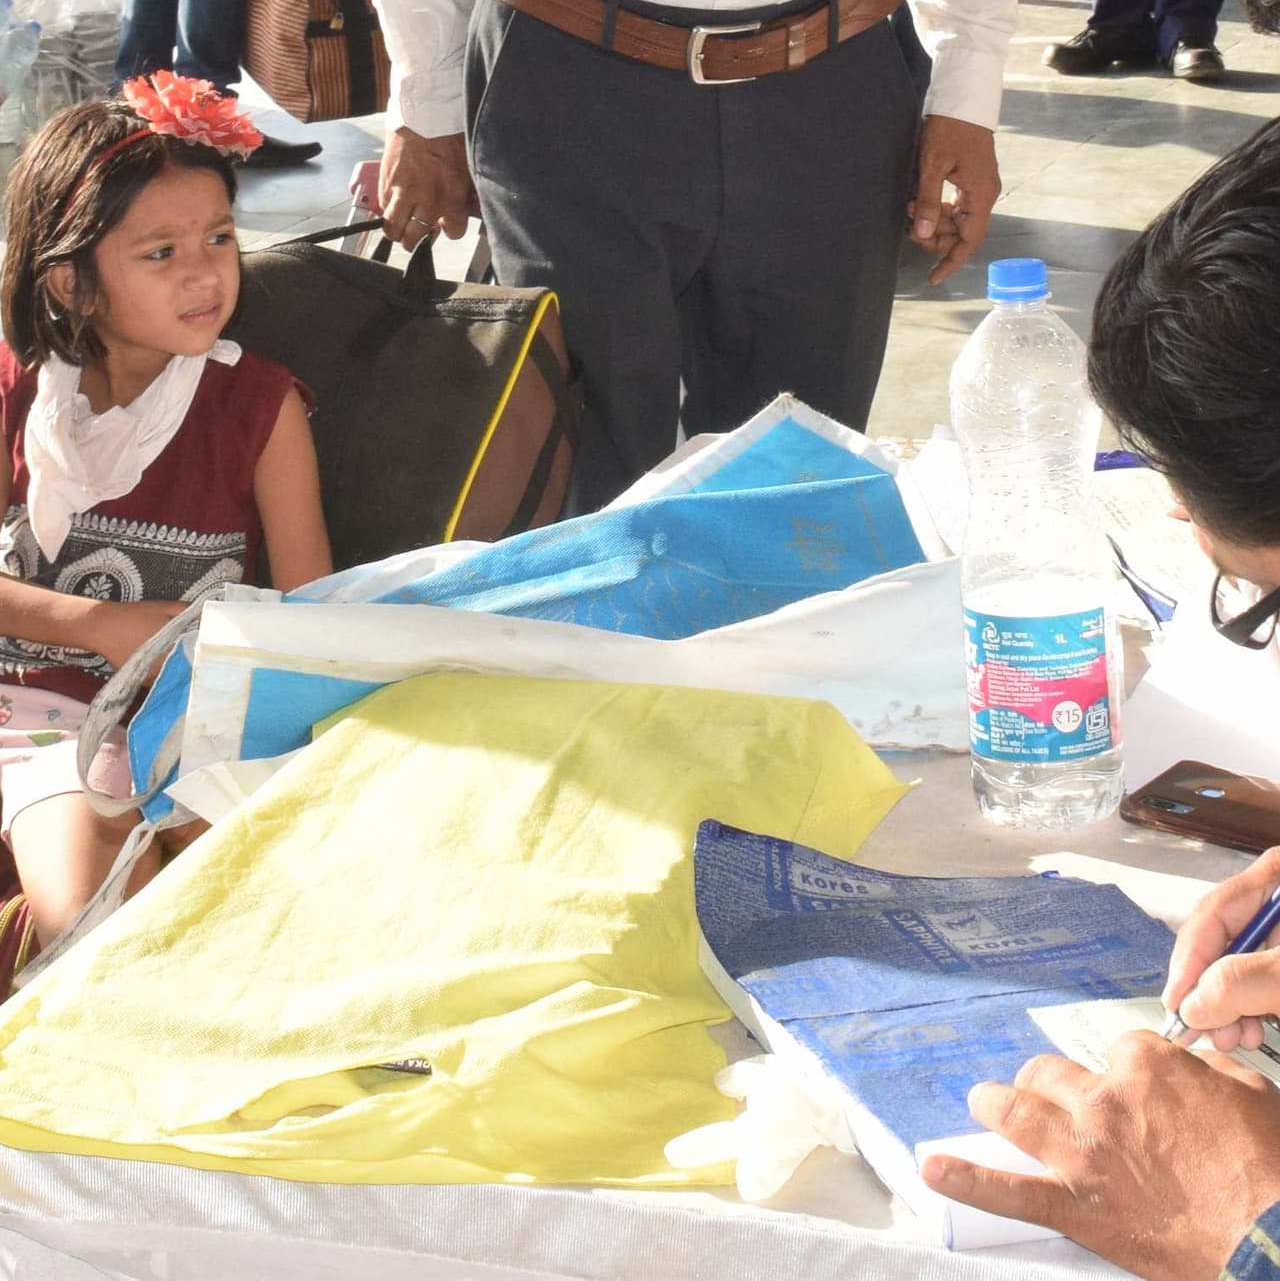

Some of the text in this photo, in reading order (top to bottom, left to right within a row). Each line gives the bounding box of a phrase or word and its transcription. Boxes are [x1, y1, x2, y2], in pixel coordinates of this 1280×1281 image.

[1054, 633, 1068, 644] 1L
[1055, 708, 1080, 725] ₹15
[800, 872, 869, 895] Kores
[894, 911, 958, 966] SAPPHIRE
